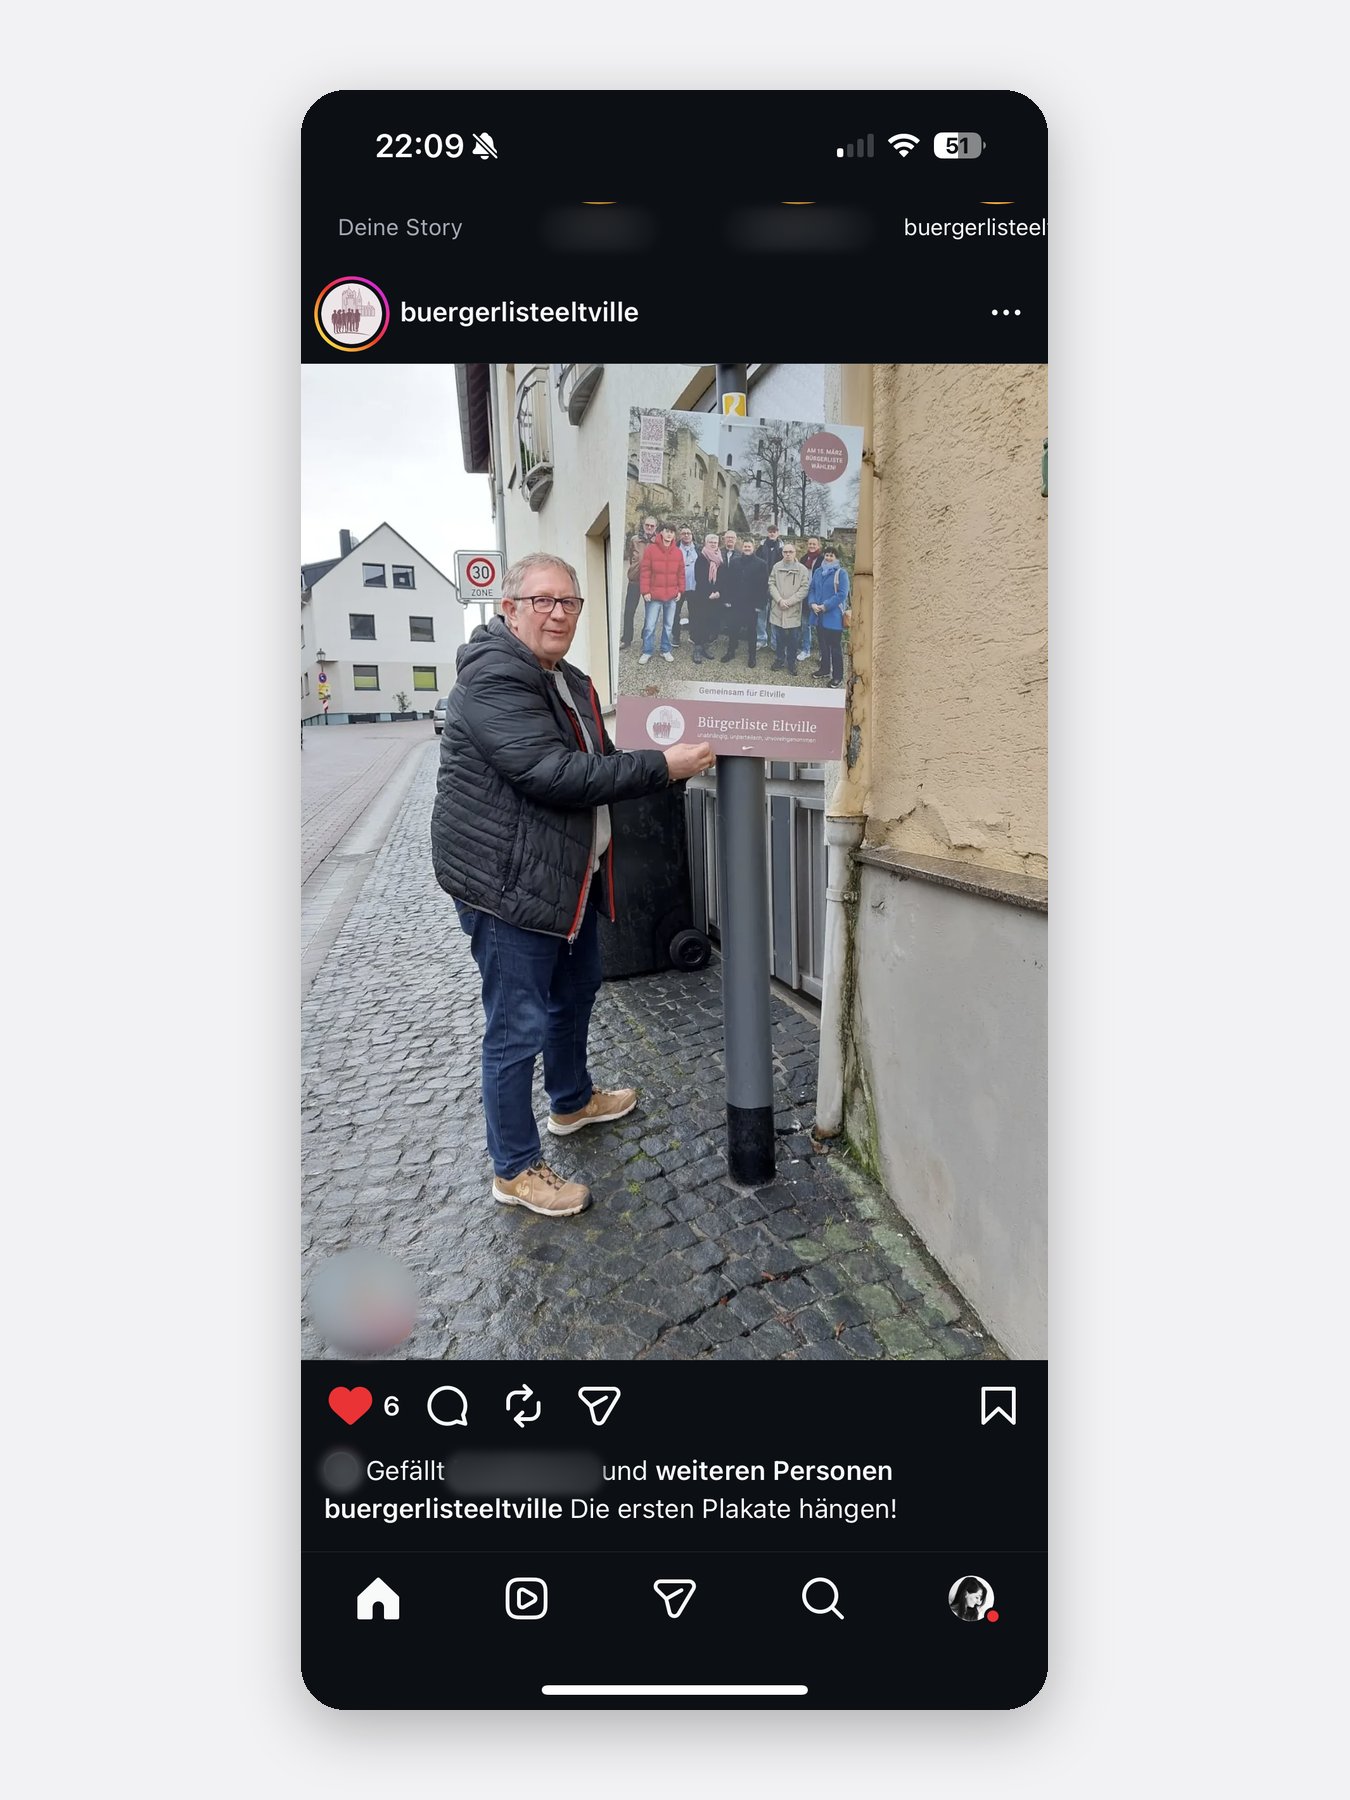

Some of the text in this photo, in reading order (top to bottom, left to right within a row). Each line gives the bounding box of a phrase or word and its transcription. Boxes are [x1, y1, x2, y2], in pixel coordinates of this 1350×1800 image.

[376, 133, 464, 159] 22:09
[946, 137, 968, 155] 51
[338, 217, 463, 241] Deine Story
[904, 217, 1048, 241] buergerlisteel
[401, 300, 639, 328] buergerlisteeltville
[472, 565, 490, 580] 30
[471, 588, 493, 596] ZONE
[698, 686, 745, 697] Gemeinsam
[759, 689, 786, 699] Eltville
[698, 716, 817, 734] Bürgerliste Eltville
[383, 1395, 400, 1417] 6
[366, 1459, 893, 1482] Gefällt und weiteren Personen
[325, 1496, 897, 1524] buergerlisteeltville Die ersten Plakate hängen!
